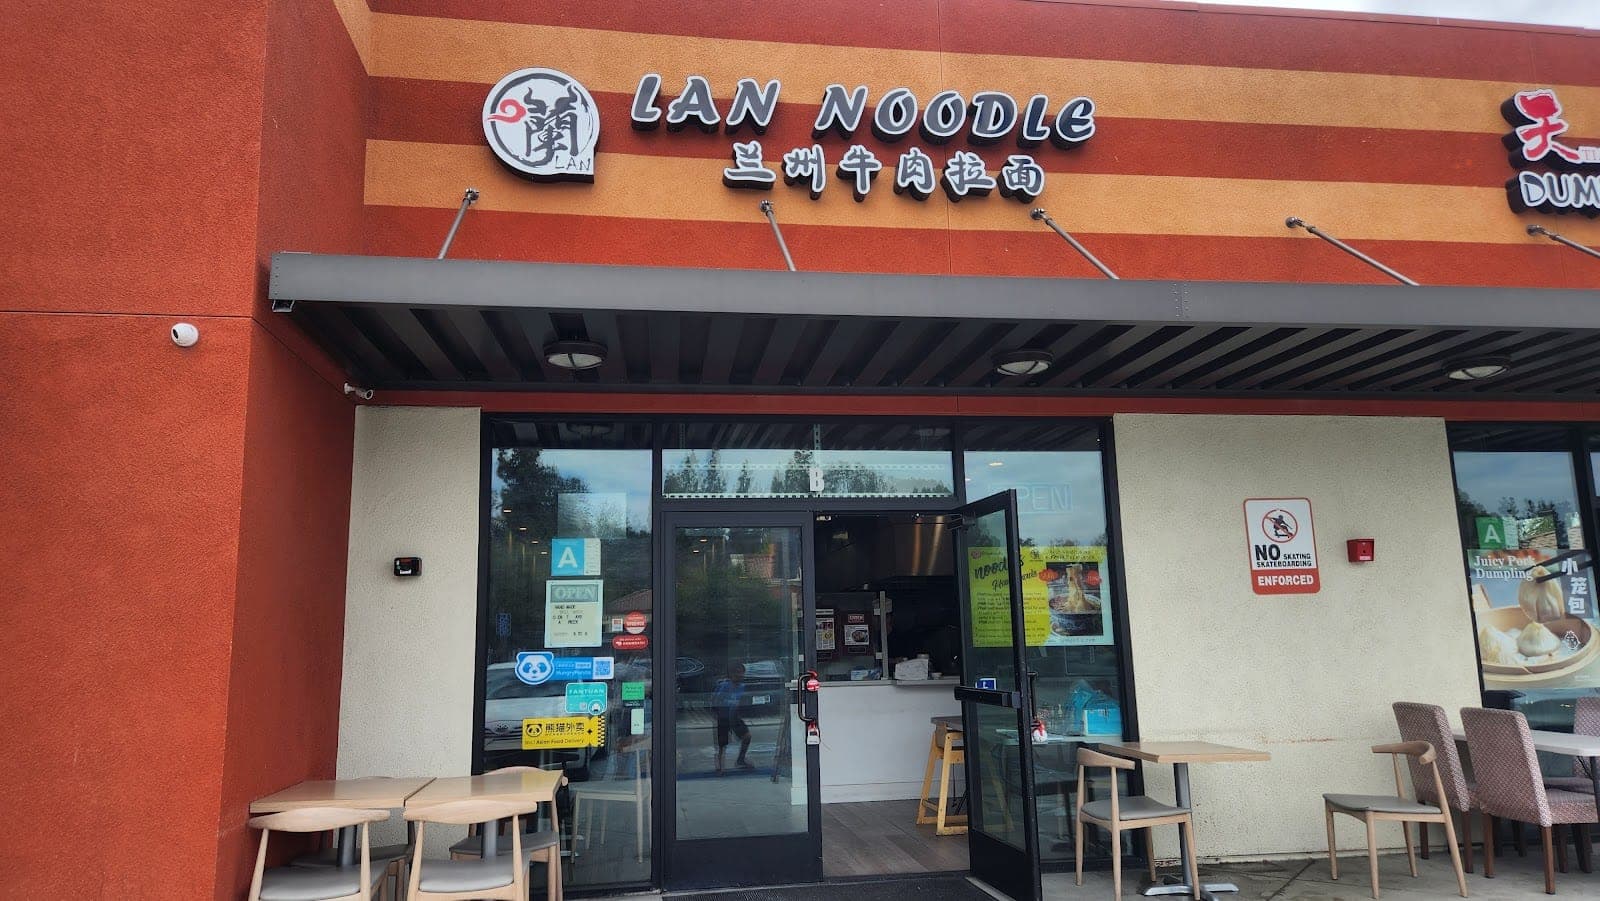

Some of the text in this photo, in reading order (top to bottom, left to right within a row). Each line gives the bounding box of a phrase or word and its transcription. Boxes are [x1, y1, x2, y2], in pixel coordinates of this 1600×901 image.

[631, 73, 1096, 143] LAN NOODLE
[554, 154, 592, 171] LAN
[723, 139, 1046, 196] 兰州牛肉拉面
[809, 466, 825, 492] B
[1016, 485, 1071, 512] PEN
[1484, 524, 1501, 544] A
[557, 546, 578, 568] A
[1254, 543, 1281, 561] NO
[1256, 560, 1312, 568] SKATEBOARDING
[1473, 555, 1504, 569] Juicy
[1257, 574, 1314, 586] ENFORCED
[1475, 568, 1534, 582] Dumpling
[555, 586, 597, 600] OPEN
[545, 722, 585, 733] 熊猫外卖
